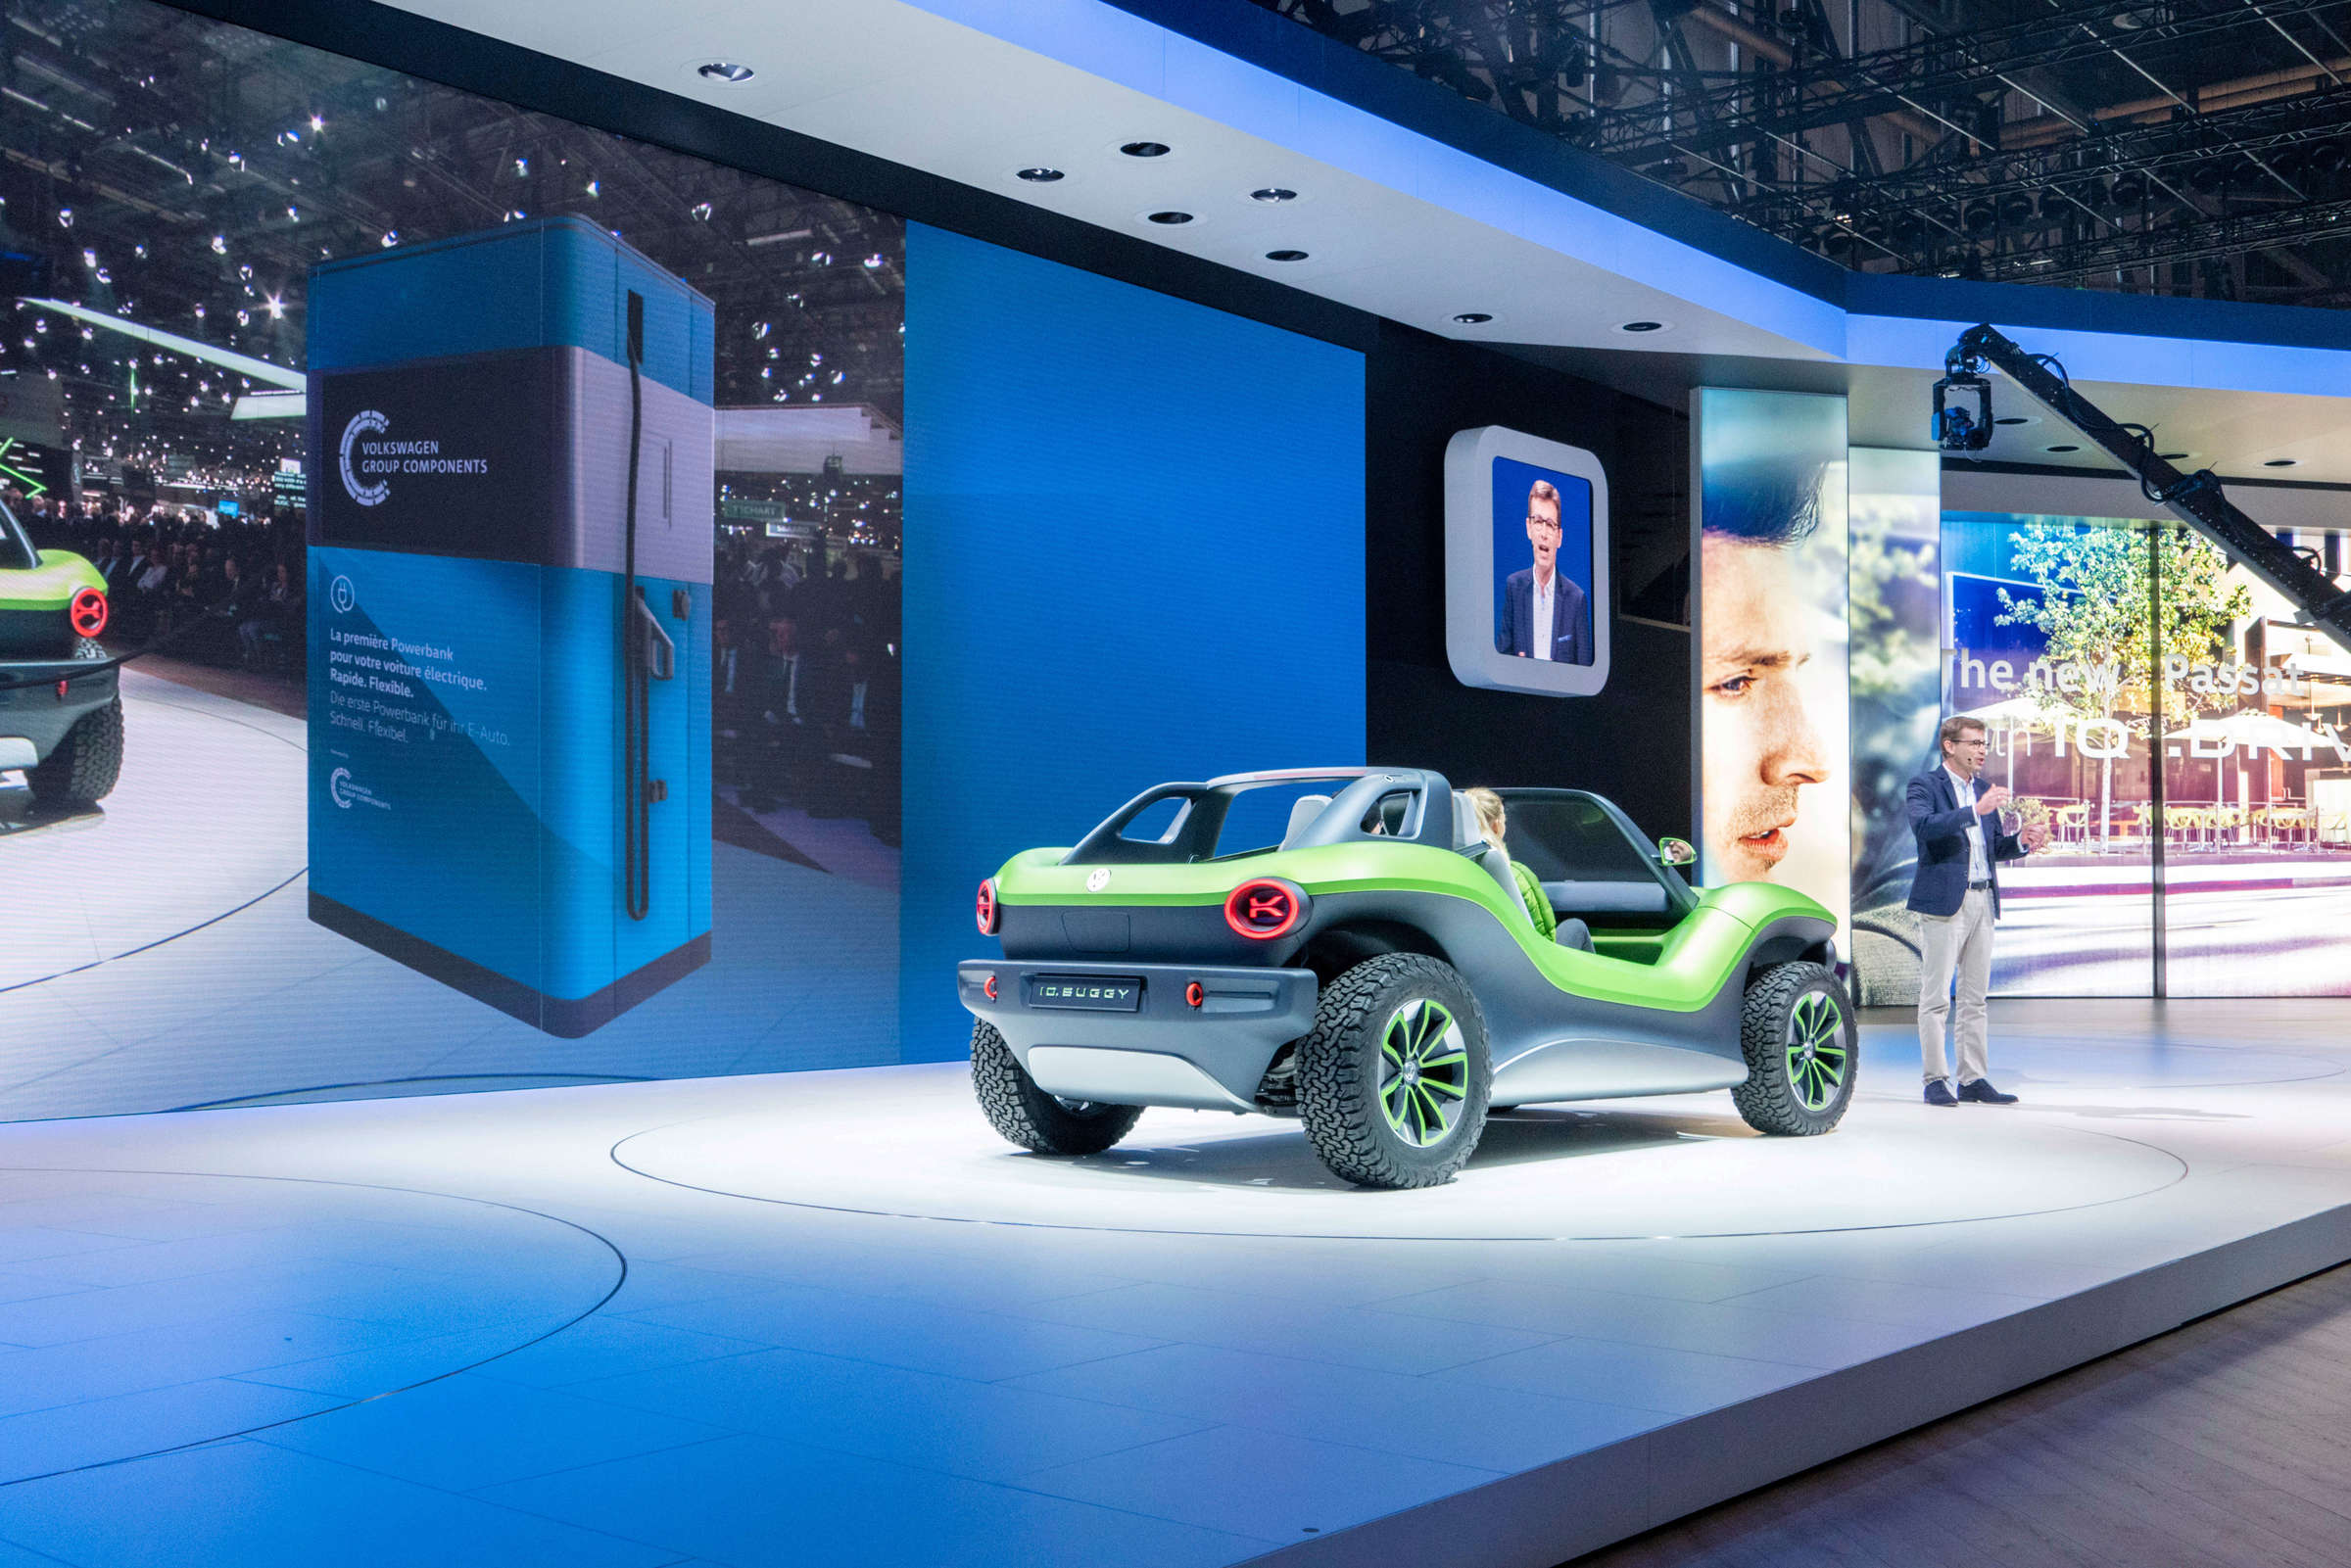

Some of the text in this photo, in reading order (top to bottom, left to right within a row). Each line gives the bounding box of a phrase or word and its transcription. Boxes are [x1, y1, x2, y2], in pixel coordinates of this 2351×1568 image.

[362, 441, 439, 454] VOLKSWAGEN
[362, 458, 488, 474] GROUP COMPONENTS
[330, 628, 454, 661] La première Powerbank
[330, 650, 487, 690] pour votre voiture électrique.
[330, 668, 414, 697] Rapide. Flexible.
[2029, 659, 2121, 692] new
[2165, 653, 2304, 696] Passat
[330, 689, 345, 705] Die
[347, 696, 371, 713] erste
[373, 700, 430, 726] Powerbank
[330, 710, 408, 743] Schnell. Flexibel.
